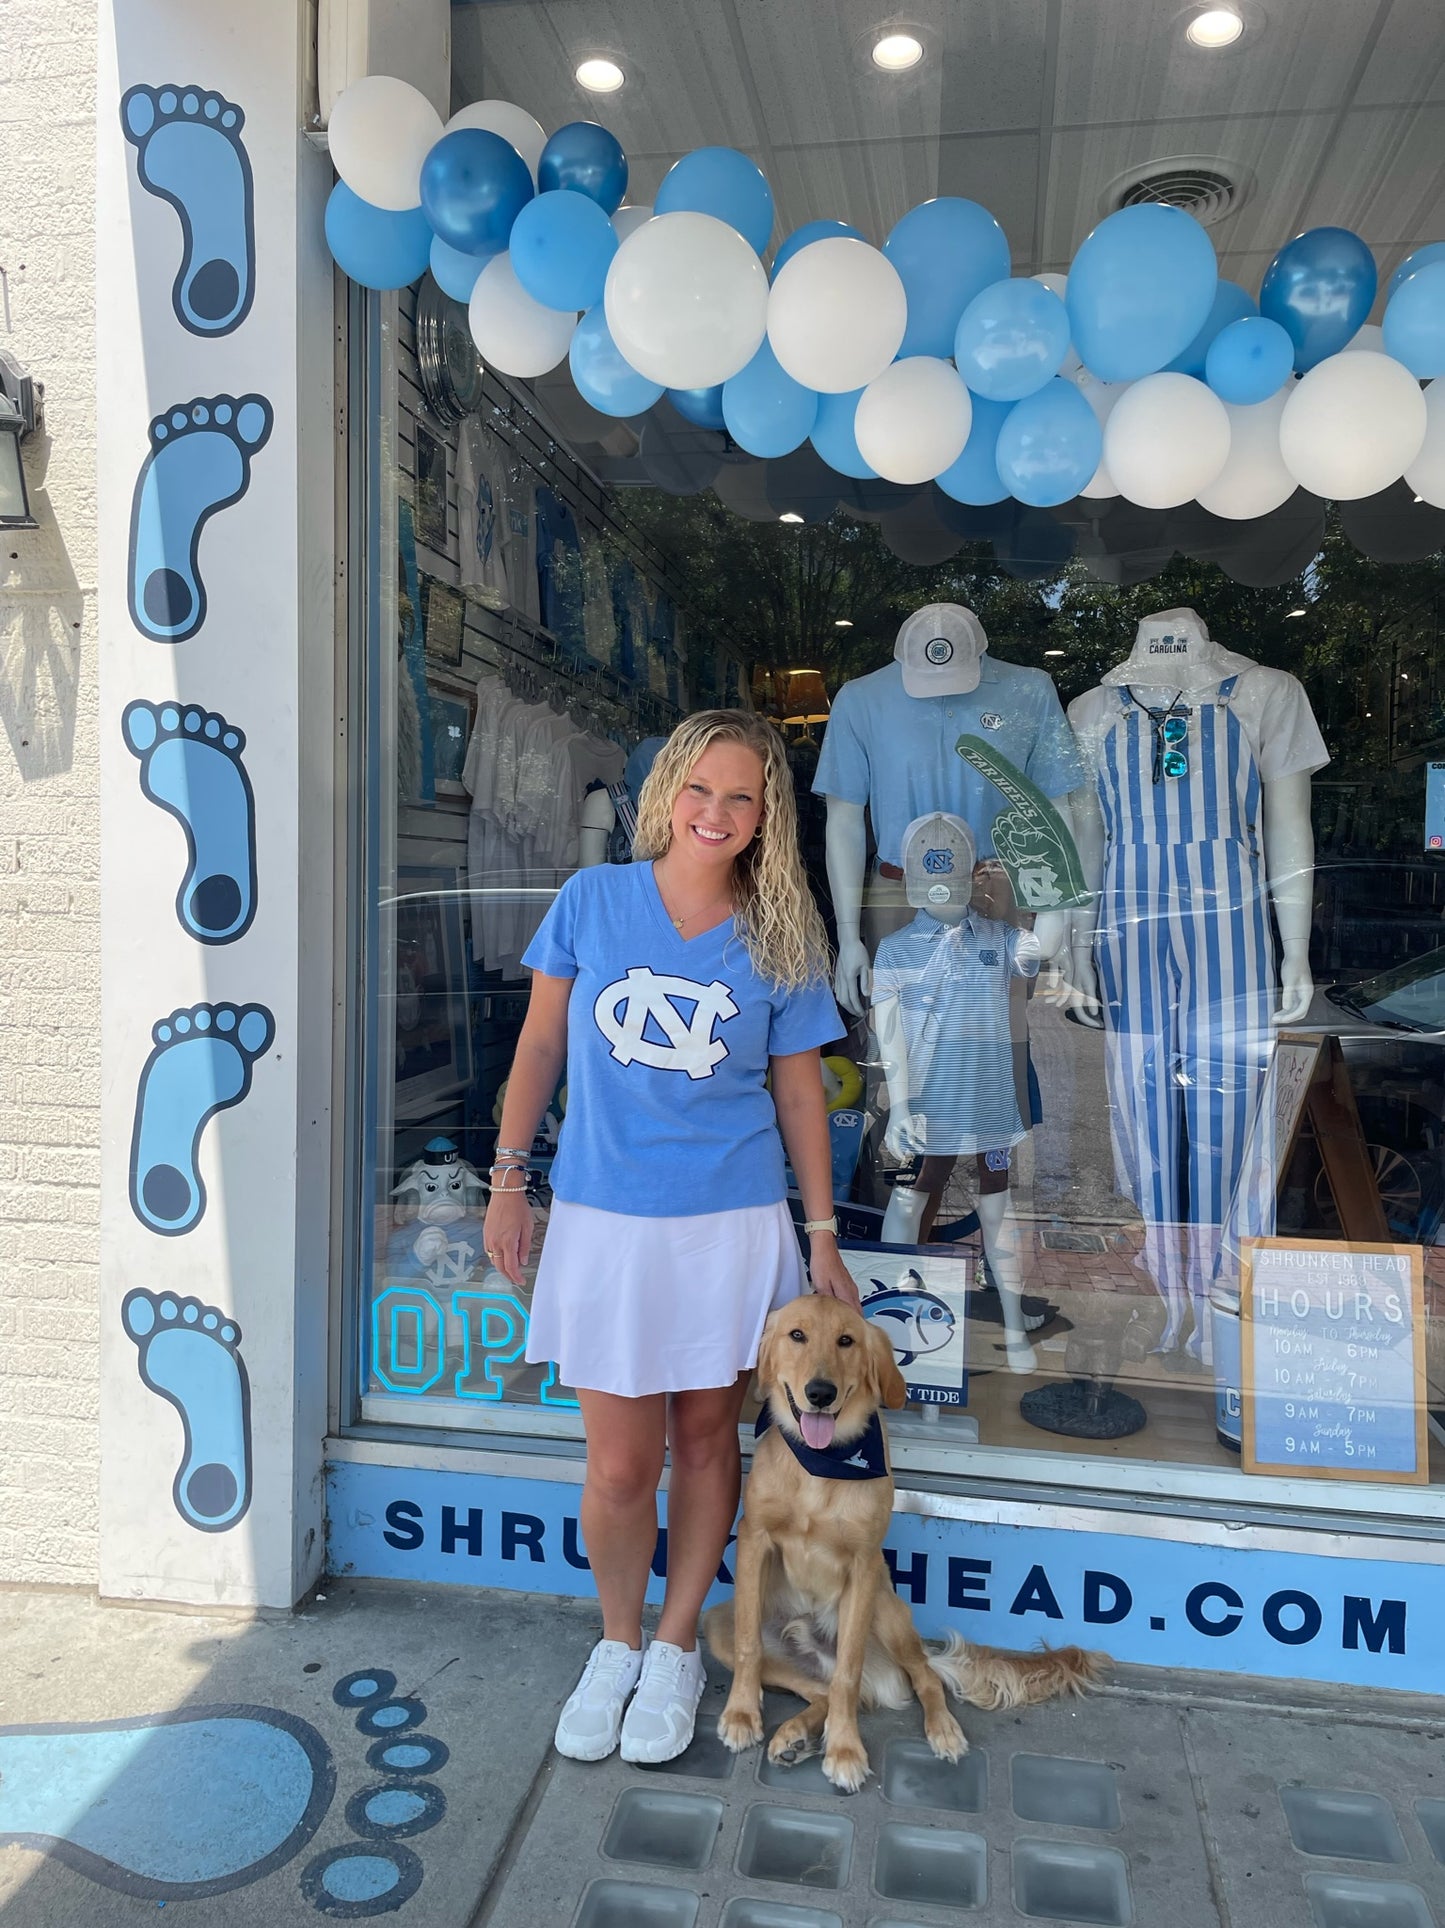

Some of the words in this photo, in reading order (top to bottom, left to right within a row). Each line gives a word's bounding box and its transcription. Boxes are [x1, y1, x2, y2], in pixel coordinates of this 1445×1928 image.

[1149, 644, 1188, 654] CAROLINA
[966, 752, 997, 777] TAR
[992, 777, 1039, 820] HEELS
[1259, 1250, 1354, 1270] SHRUNKEN
[1362, 1255, 1408, 1273] HEAD
[1260, 1287, 1405, 1323] HOURS
[1320, 1326, 1338, 1340] TO
[917, 1388, 960, 1404] TIDE
[1312, 1422, 1353, 1442] Sunday
